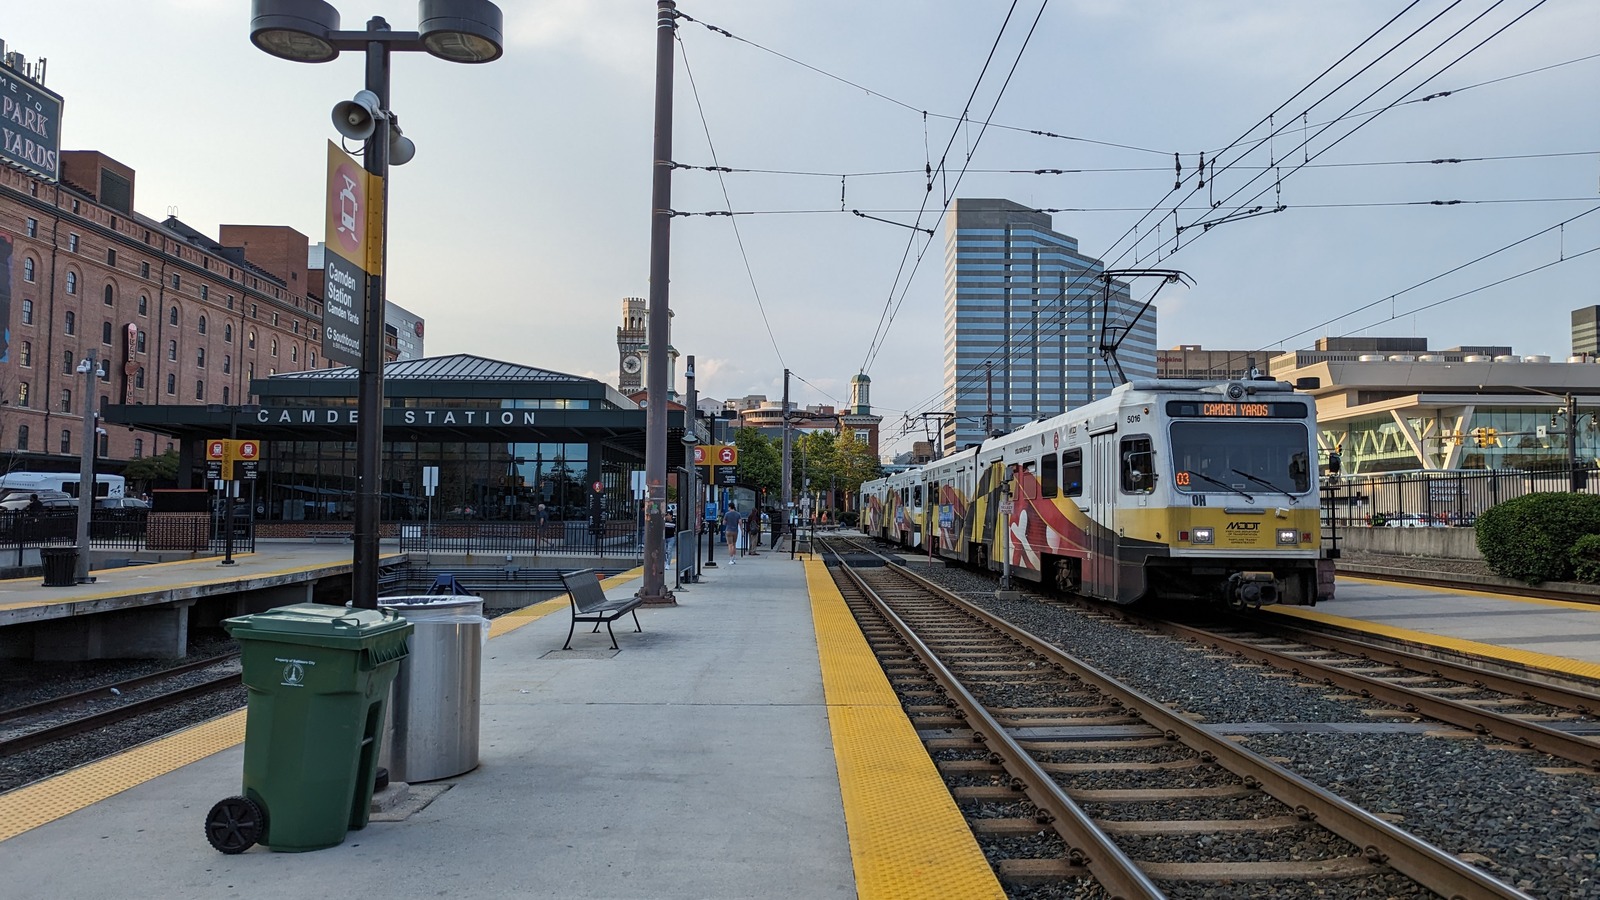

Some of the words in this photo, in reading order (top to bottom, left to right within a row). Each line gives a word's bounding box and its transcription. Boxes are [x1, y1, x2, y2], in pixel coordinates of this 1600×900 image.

[25, 93, 42, 111] TO
[2, 95, 48, 139] PARK
[2, 127, 56, 172] YARDS
[328, 262, 356, 292] Camden
[328, 281, 352, 308] Station
[327, 300, 347, 320] Camden
[346, 309, 360, 326] Yards
[332, 329, 360, 350] Southbound
[257, 409, 358, 424] CAMDE
[405, 410, 536, 425] STATION
[1127, 414, 1141, 424] 5016
[1203, 403, 1237, 416] CAMDEN
[1240, 403, 1269, 417] YARDS
[1176, 472, 1190, 485] 03
[1192, 494, 1207, 507] OH
